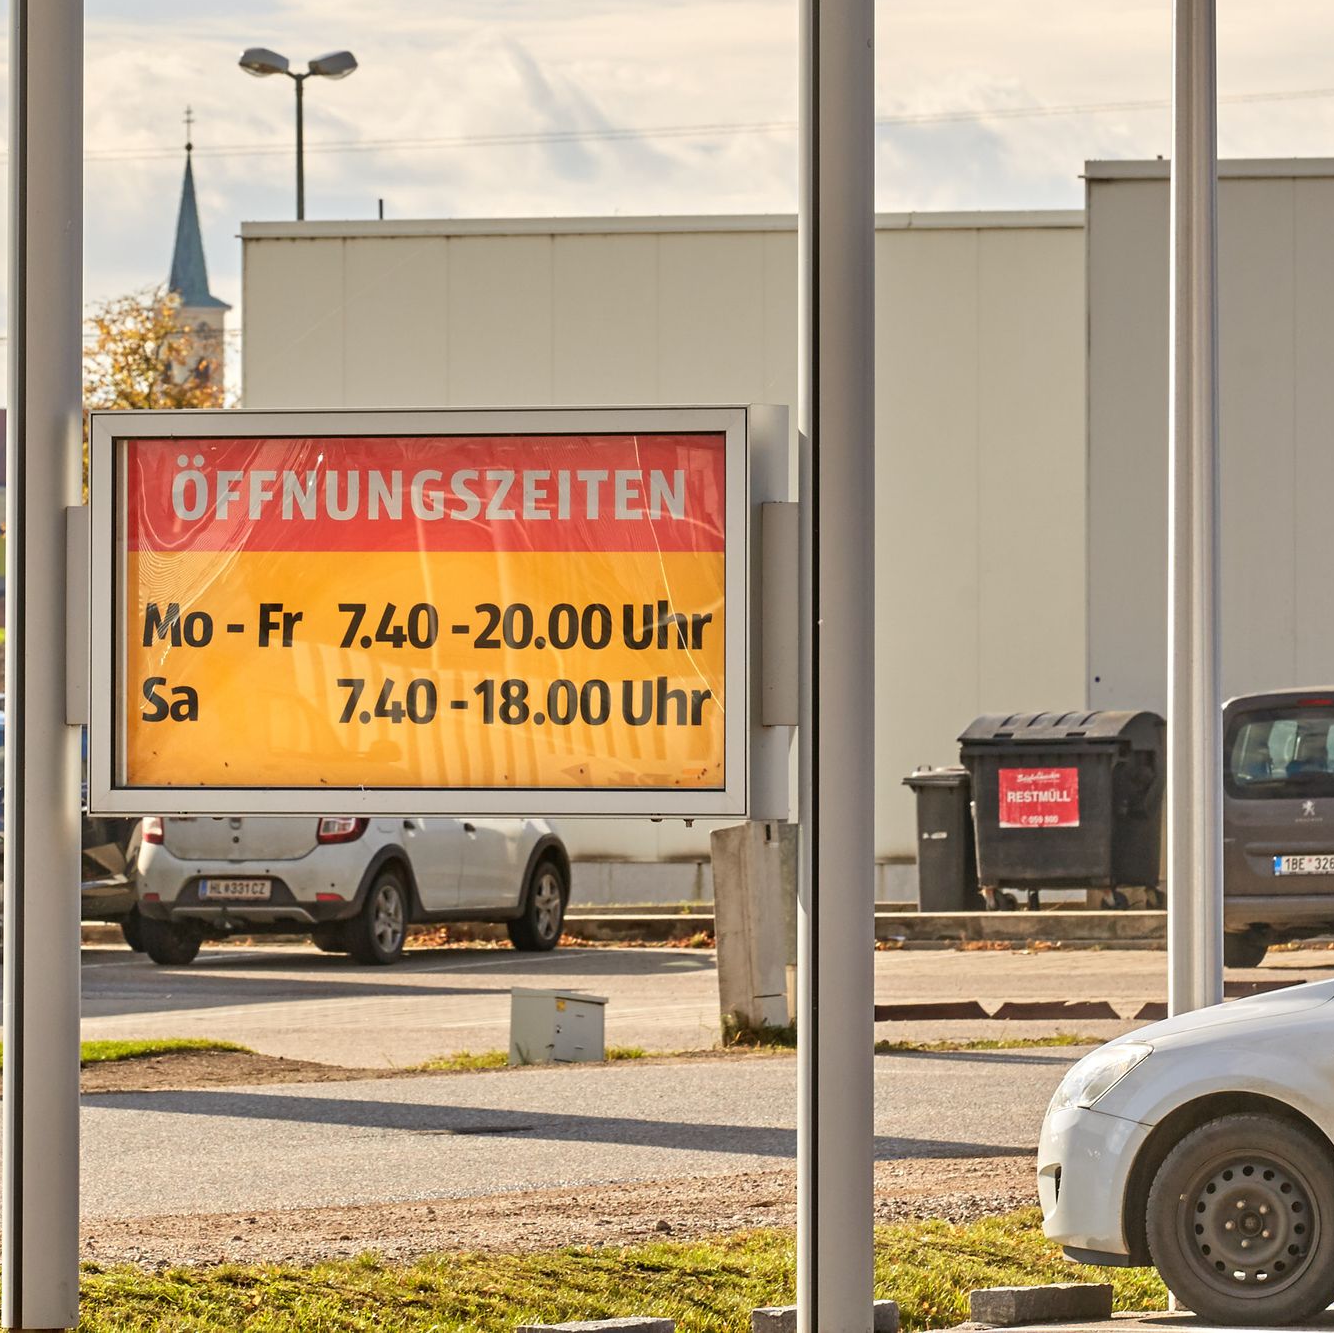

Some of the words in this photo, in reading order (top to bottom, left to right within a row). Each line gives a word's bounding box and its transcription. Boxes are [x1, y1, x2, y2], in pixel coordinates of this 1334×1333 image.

[171, 454, 686, 522] ÖFFNUNGSZEITEN
[142, 602, 212, 649] Mo
[258, 602, 303, 649] Fr
[338, 603, 439, 649] 7.40
[622, 600, 712, 650] Uhr
[141, 676, 200, 723] Sa
[337, 677, 439, 725] 7.40
[622, 678, 712, 727] Uhr
[1007, 788, 1072, 803] RESTMÜLL
[1285, 858, 1306, 871] 1BE
